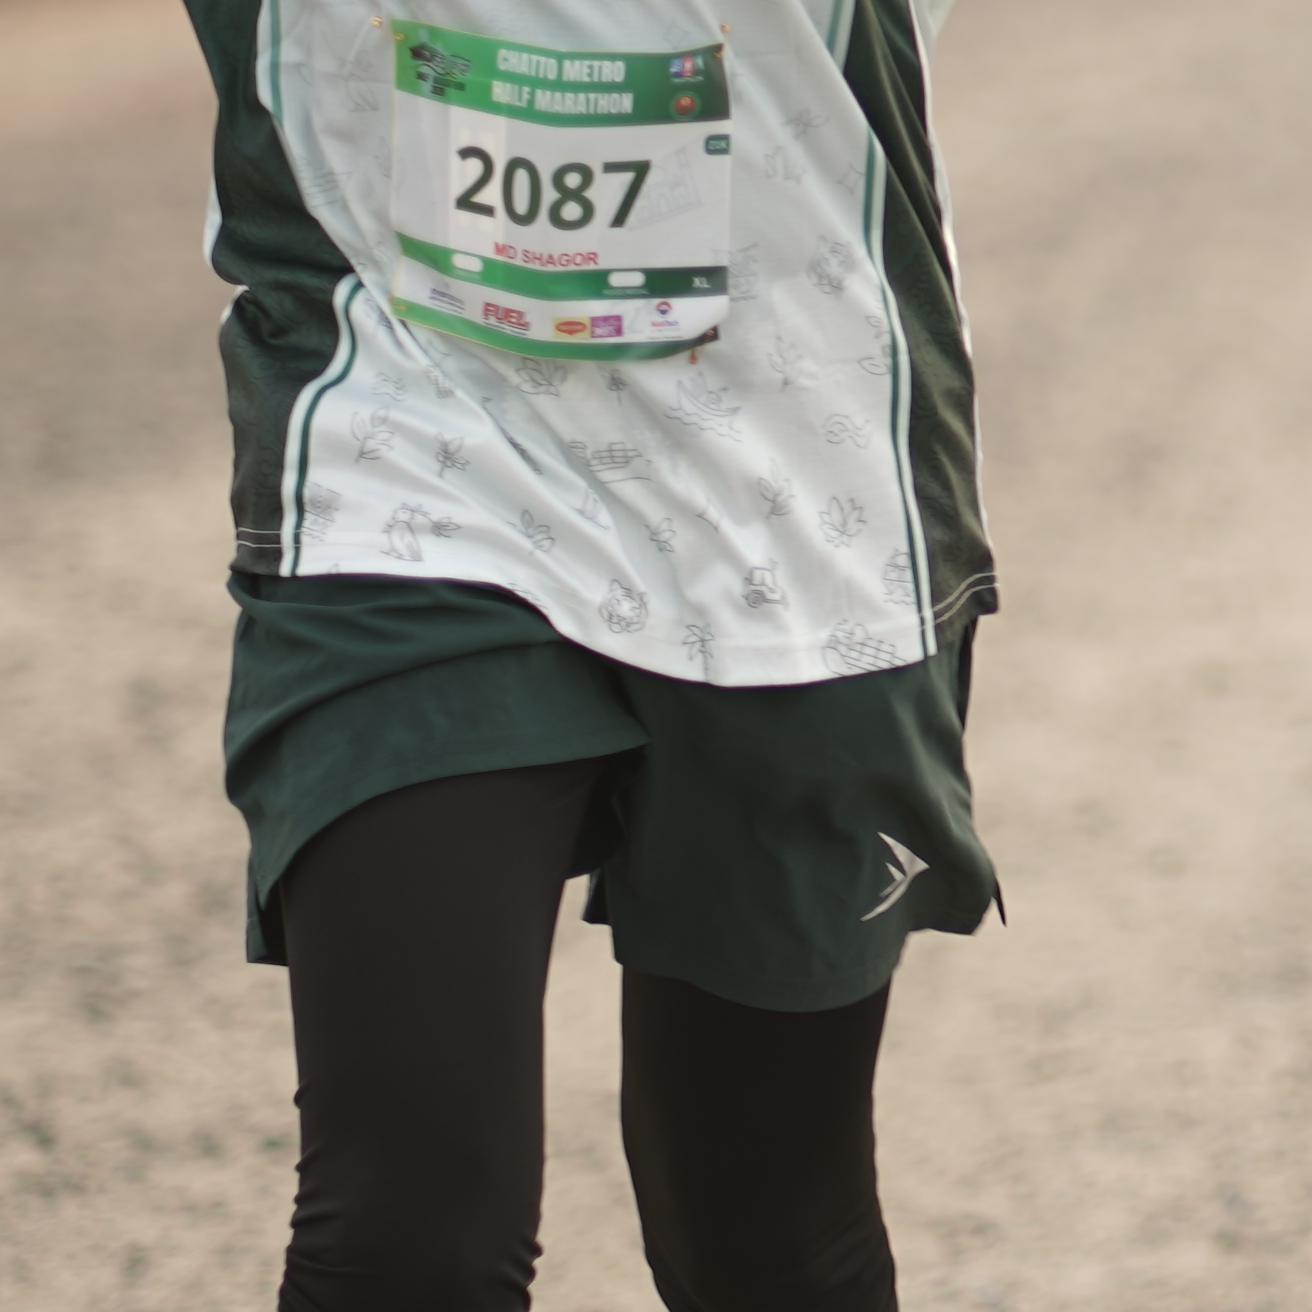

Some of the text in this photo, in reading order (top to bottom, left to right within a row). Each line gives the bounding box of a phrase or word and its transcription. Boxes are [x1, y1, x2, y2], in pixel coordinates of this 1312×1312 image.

[496, 48, 558, 80] CHATTO
[561, 59, 626, 83] METRO
[491, 80, 531, 108] HALF
[533, 88, 635, 114] MARATHON
[454, 145, 652, 231] 2087
[494, 241, 599, 267] MD SHAGOR
[483, 302, 531, 329] FUEL
